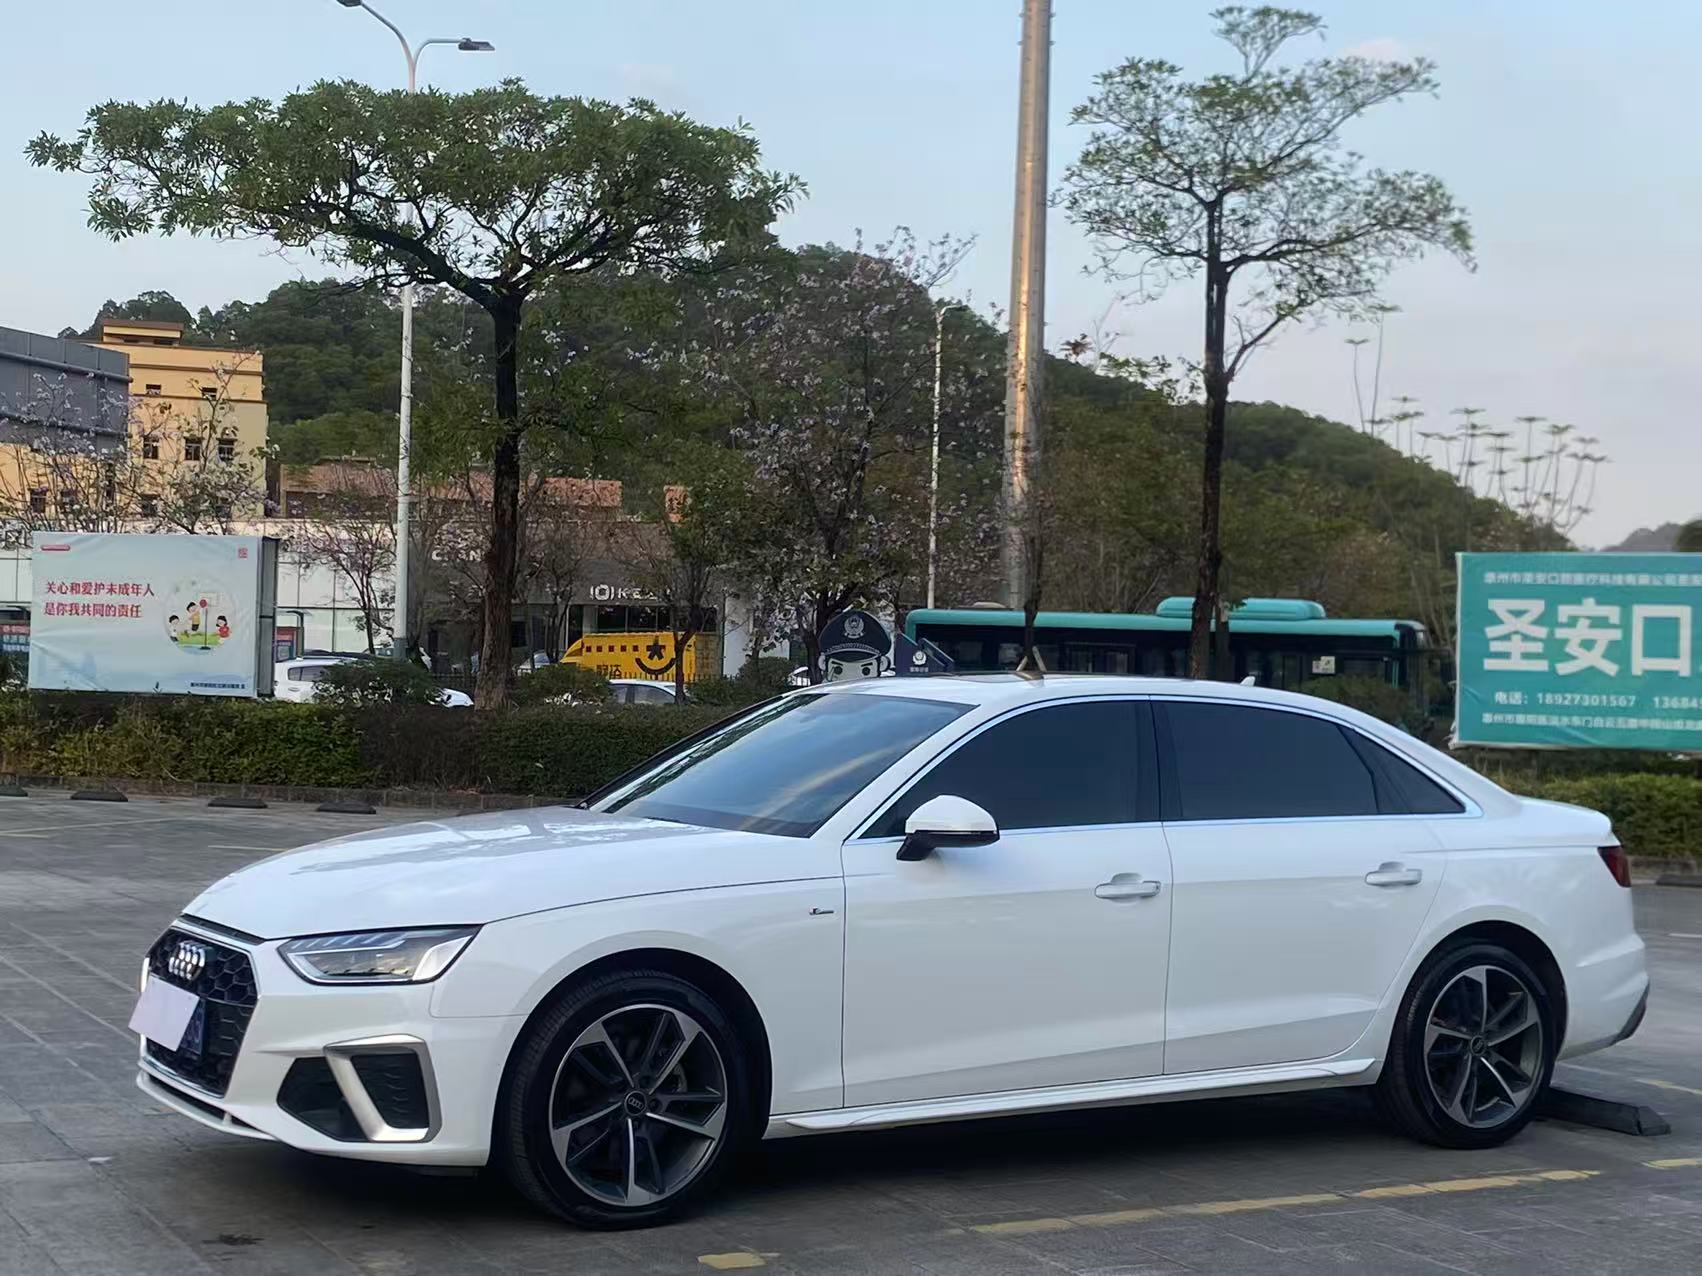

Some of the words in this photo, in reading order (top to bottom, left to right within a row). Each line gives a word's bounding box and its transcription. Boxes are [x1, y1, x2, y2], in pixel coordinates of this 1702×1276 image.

[46, 581, 155, 597] 关心和爱护未成年人
[44, 602, 143, 618] 是你我共同的责任
[1483, 597, 1702, 677] 圣安口
